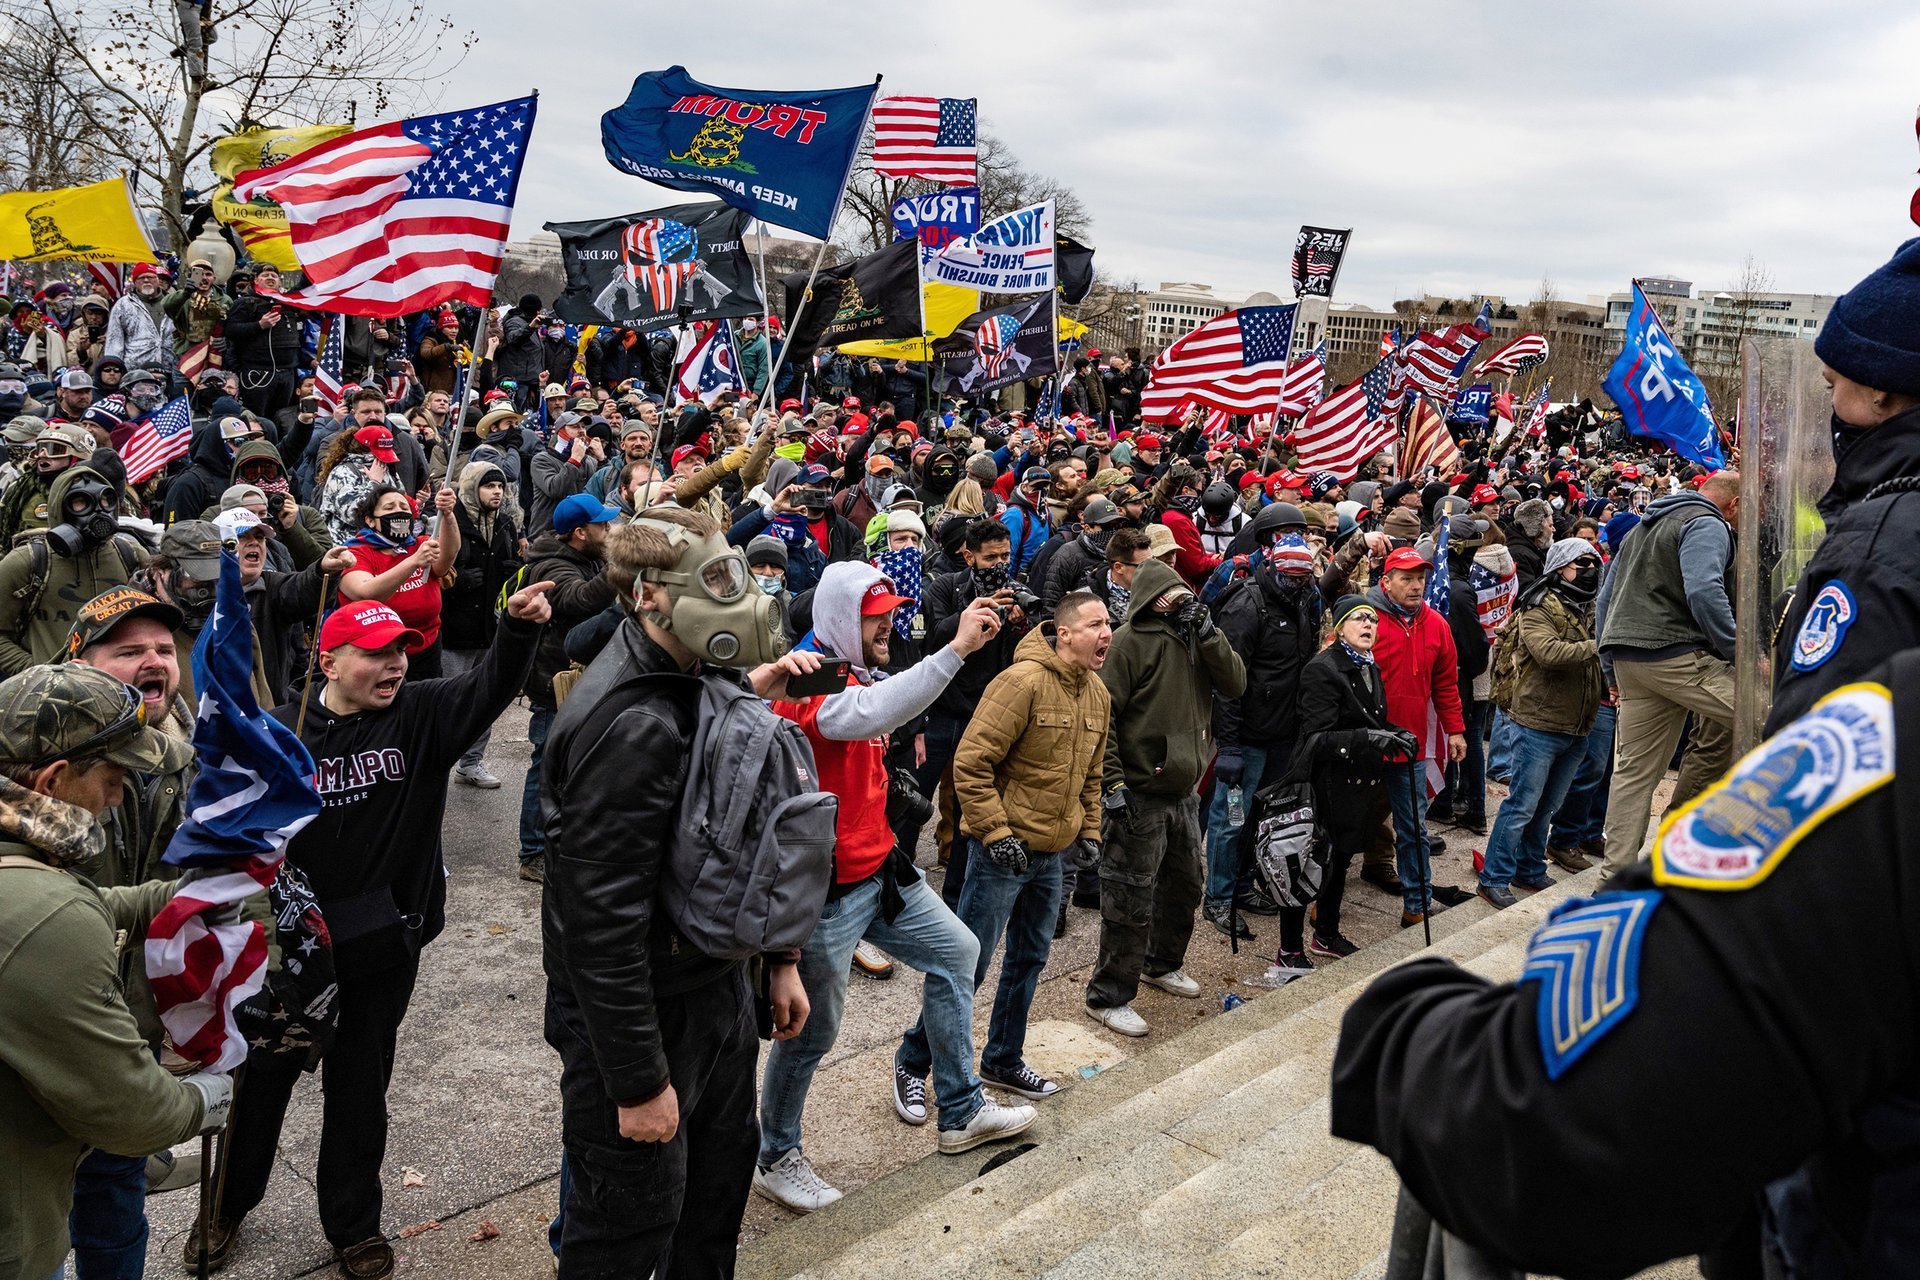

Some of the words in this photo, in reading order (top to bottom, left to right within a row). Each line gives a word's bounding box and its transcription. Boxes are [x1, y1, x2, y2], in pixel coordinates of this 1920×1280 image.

[831, 322, 857, 333] TREAD
[860, 320, 872, 328] ON
[873, 317, 885, 325] ME
[84, 592, 117, 613] MAKE
[95, 601, 132, 622] GREAT
[353, 608, 378, 621] MAKE
[361, 614, 387, 626] GREAT
[318, 748, 406, 794] MAPO
[321, 792, 368, 807] OLLEGE
